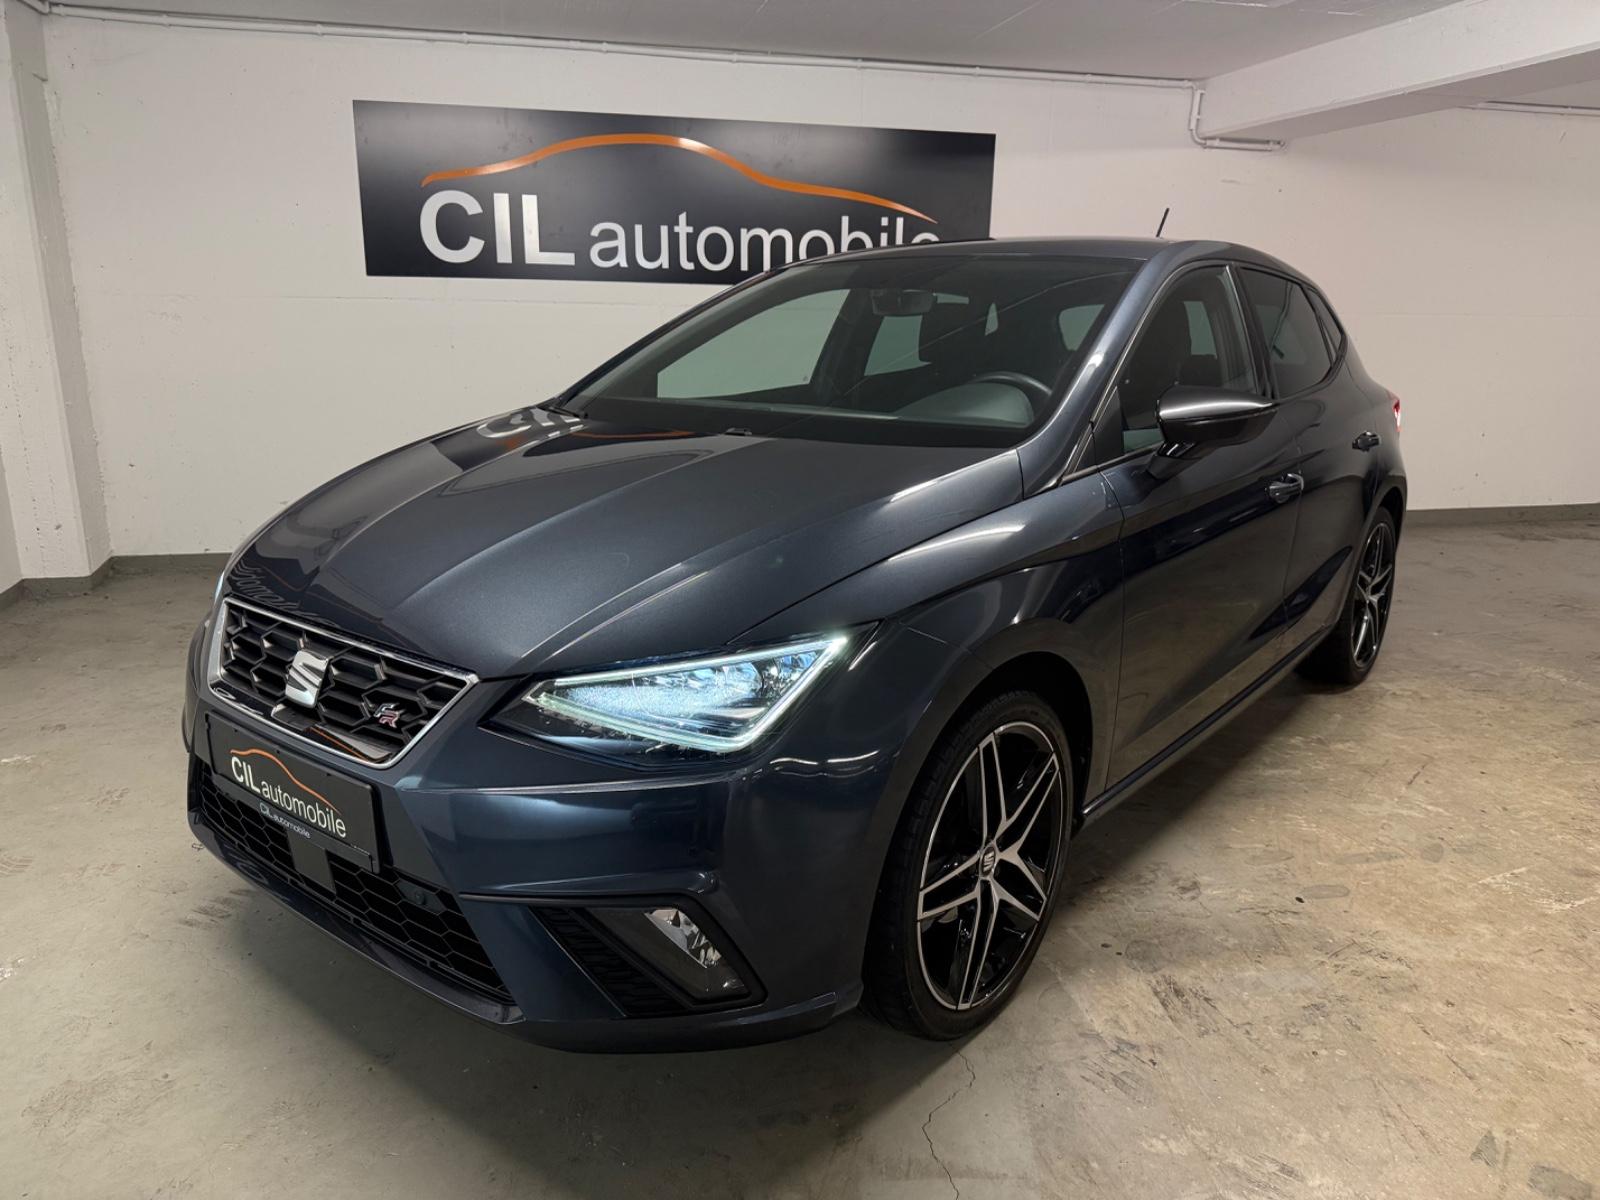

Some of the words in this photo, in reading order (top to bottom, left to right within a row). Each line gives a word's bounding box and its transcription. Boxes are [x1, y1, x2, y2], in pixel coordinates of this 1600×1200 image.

[420, 190, 575, 266] CIL
[590, 211, 940, 272] automobil
[231, 756, 261, 793] CIL
[261, 780, 347, 838] automobile
